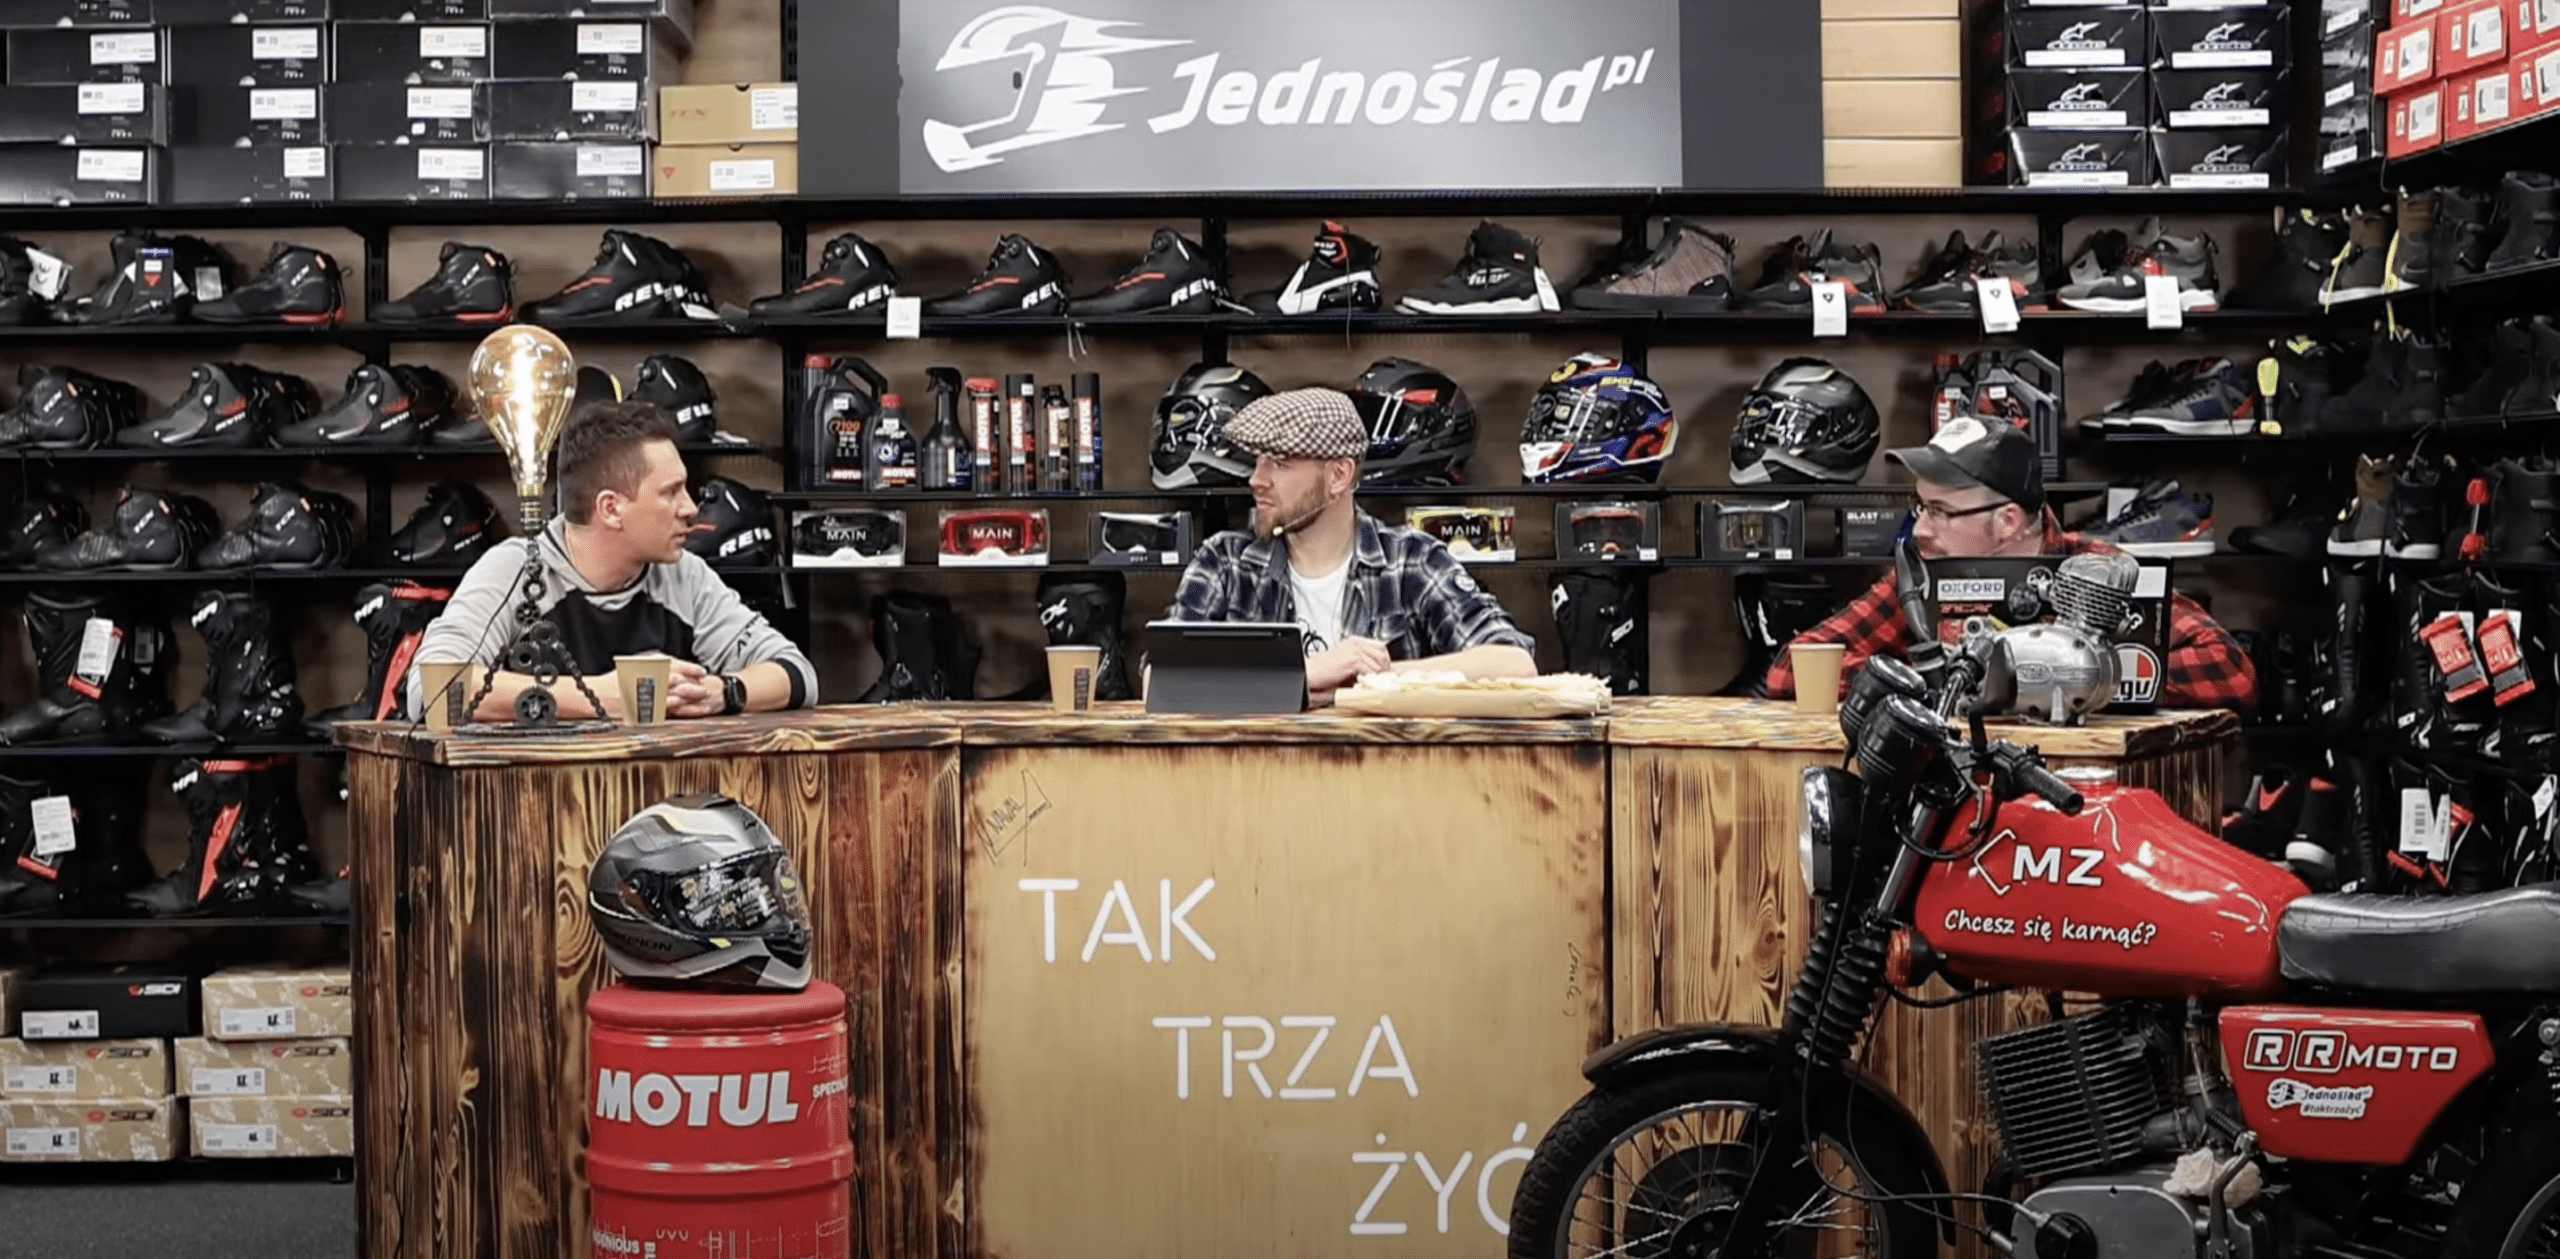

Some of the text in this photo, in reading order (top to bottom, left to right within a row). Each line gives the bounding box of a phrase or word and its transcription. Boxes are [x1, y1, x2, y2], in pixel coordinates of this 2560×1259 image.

[1147, 52, 1605, 134] Jednoślad
[881, 467, 916, 479] MOTUL
[1847, 511, 1878, 520] BLAST
[827, 530, 866, 542] MAIN
[972, 528, 1013, 540] MAIN
[1441, 525, 1481, 536] MAIN
[1942, 582, 2003, 593] OXFORD
[2113, 679, 2151, 702] gv
[2012, 844, 2105, 887] MZ
[1018, 878, 1216, 964] TAK
[1944, 908, 2157, 949] Chcesz się karnąć?
[143, 983, 182, 996] SIDI
[107, 1047, 152, 1059] SIDI
[291, 1045, 338, 1058] SIDI
[1152, 1015, 1419, 1100] TRZA
[2345, 1044, 2458, 1070] MOTO
[596, 1067, 799, 1127] MOTUL
[109, 1108, 156, 1123] SIDI
[1349, 1122, 1535, 1236] ŻYĆ
